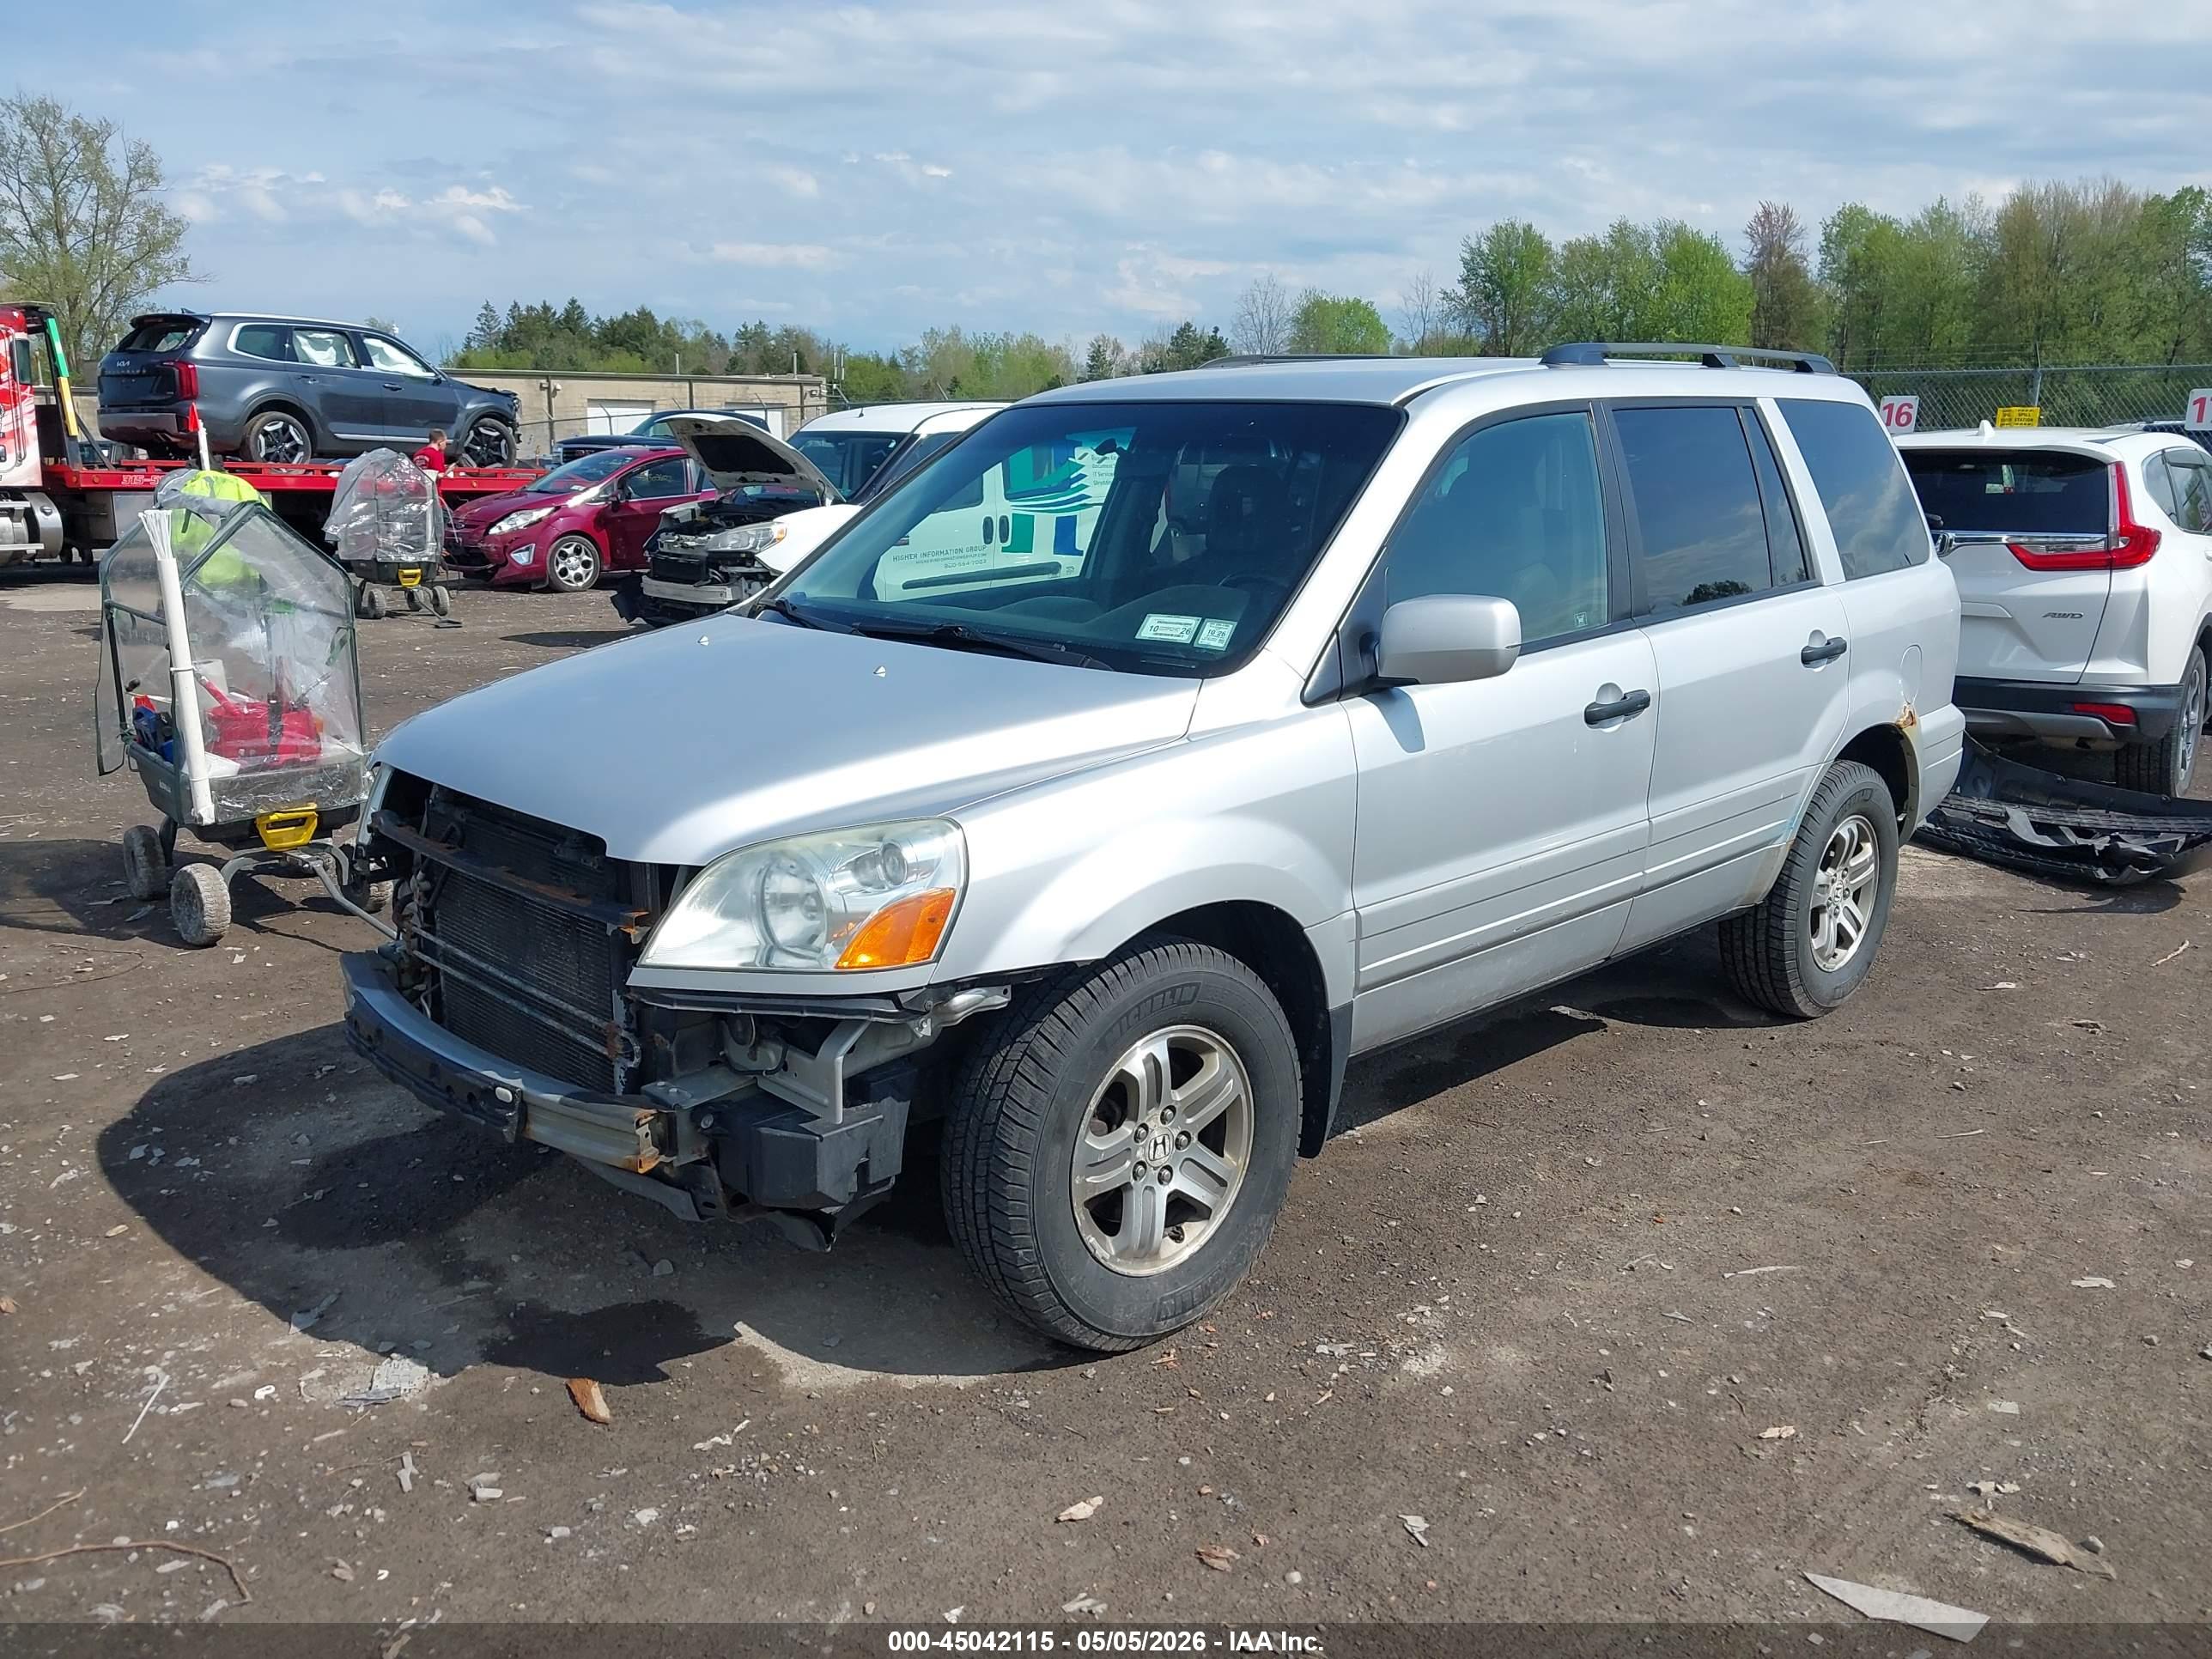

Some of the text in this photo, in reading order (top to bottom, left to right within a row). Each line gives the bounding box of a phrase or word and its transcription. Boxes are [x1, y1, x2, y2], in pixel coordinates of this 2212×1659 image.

[1882, 403, 1914, 428] 16
[2192, 397, 2212, 423] 1
[893, 553, 918, 562] HIGHER
[920, 547, 963, 559] INFORMATION
[1149, 624, 1160, 633] 10
[1179, 627, 1192, 635] 26
